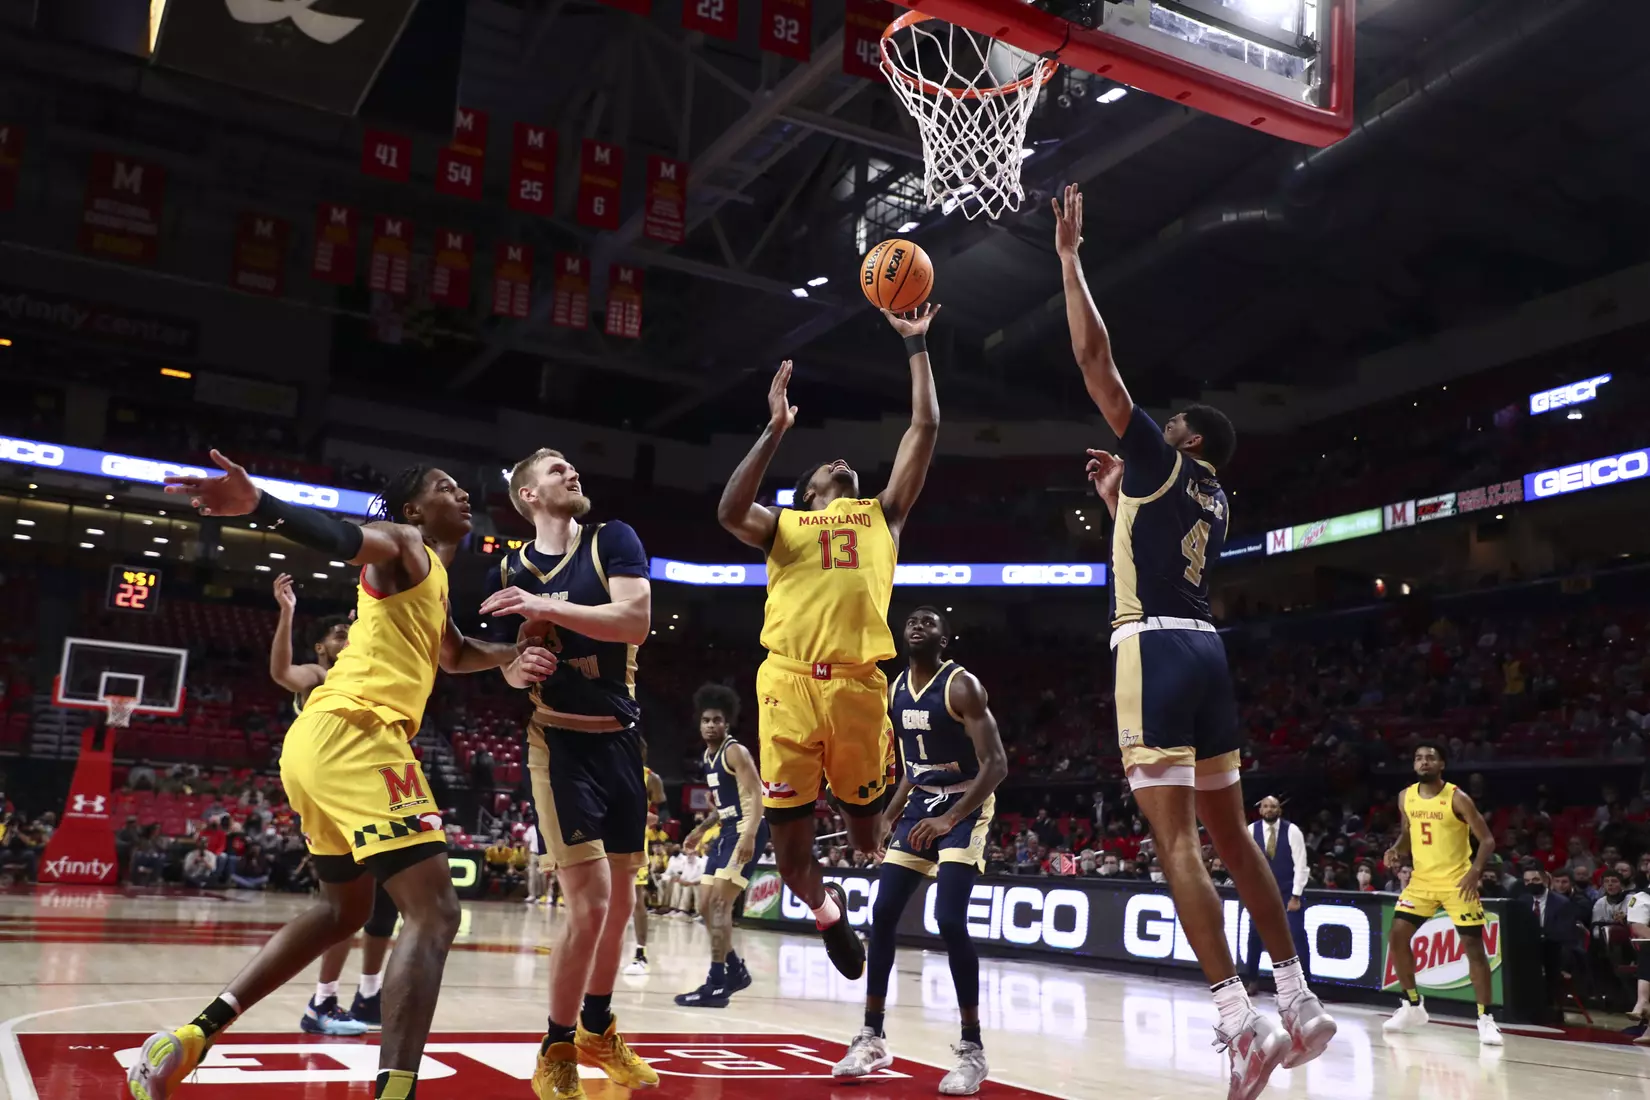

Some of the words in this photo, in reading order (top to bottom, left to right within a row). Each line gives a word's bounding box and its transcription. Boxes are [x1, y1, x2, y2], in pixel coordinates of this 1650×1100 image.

[773, 14, 800, 44] 32
[855, 37, 881, 66] 42
[528, 129, 546, 148] M
[374, 142, 398, 168] 41
[594, 145, 611, 165] M
[113, 161, 144, 194] M
[447, 160, 473, 187] 54
[660, 161, 676, 180] M
[519, 179, 543, 202] 25
[330, 207, 348, 226] M
[592, 196, 606, 216] 6
[254, 217, 275, 238] M
[385, 219, 402, 237] M
[865, 241, 889, 286] Wilson
[885, 248, 905, 282] NCAA
[1534, 451, 1648, 497] GEICO
[799, 512, 872, 528] MARYLAND
[1391, 503, 1406, 524] M
[817, 529, 859, 570] 13
[1273, 530, 1286, 551] M
[1181, 518, 1211, 587] 4
[665, 561, 746, 584] GEICO
[1002, 565, 1092, 584] GEICO
[116, 583, 149, 608] 22
[815, 663, 828, 677] M
[902, 709, 931, 730] GEORGE
[916, 734, 928, 760] 1
[378, 762, 427, 806] M
[1410, 809, 1444, 820] MARYLAND
[1421, 822, 1432, 845] 5
[44, 856, 114, 880] xfinity
[1124, 894, 1370, 980] GIO
[1384, 923, 1498, 987] LBMN
